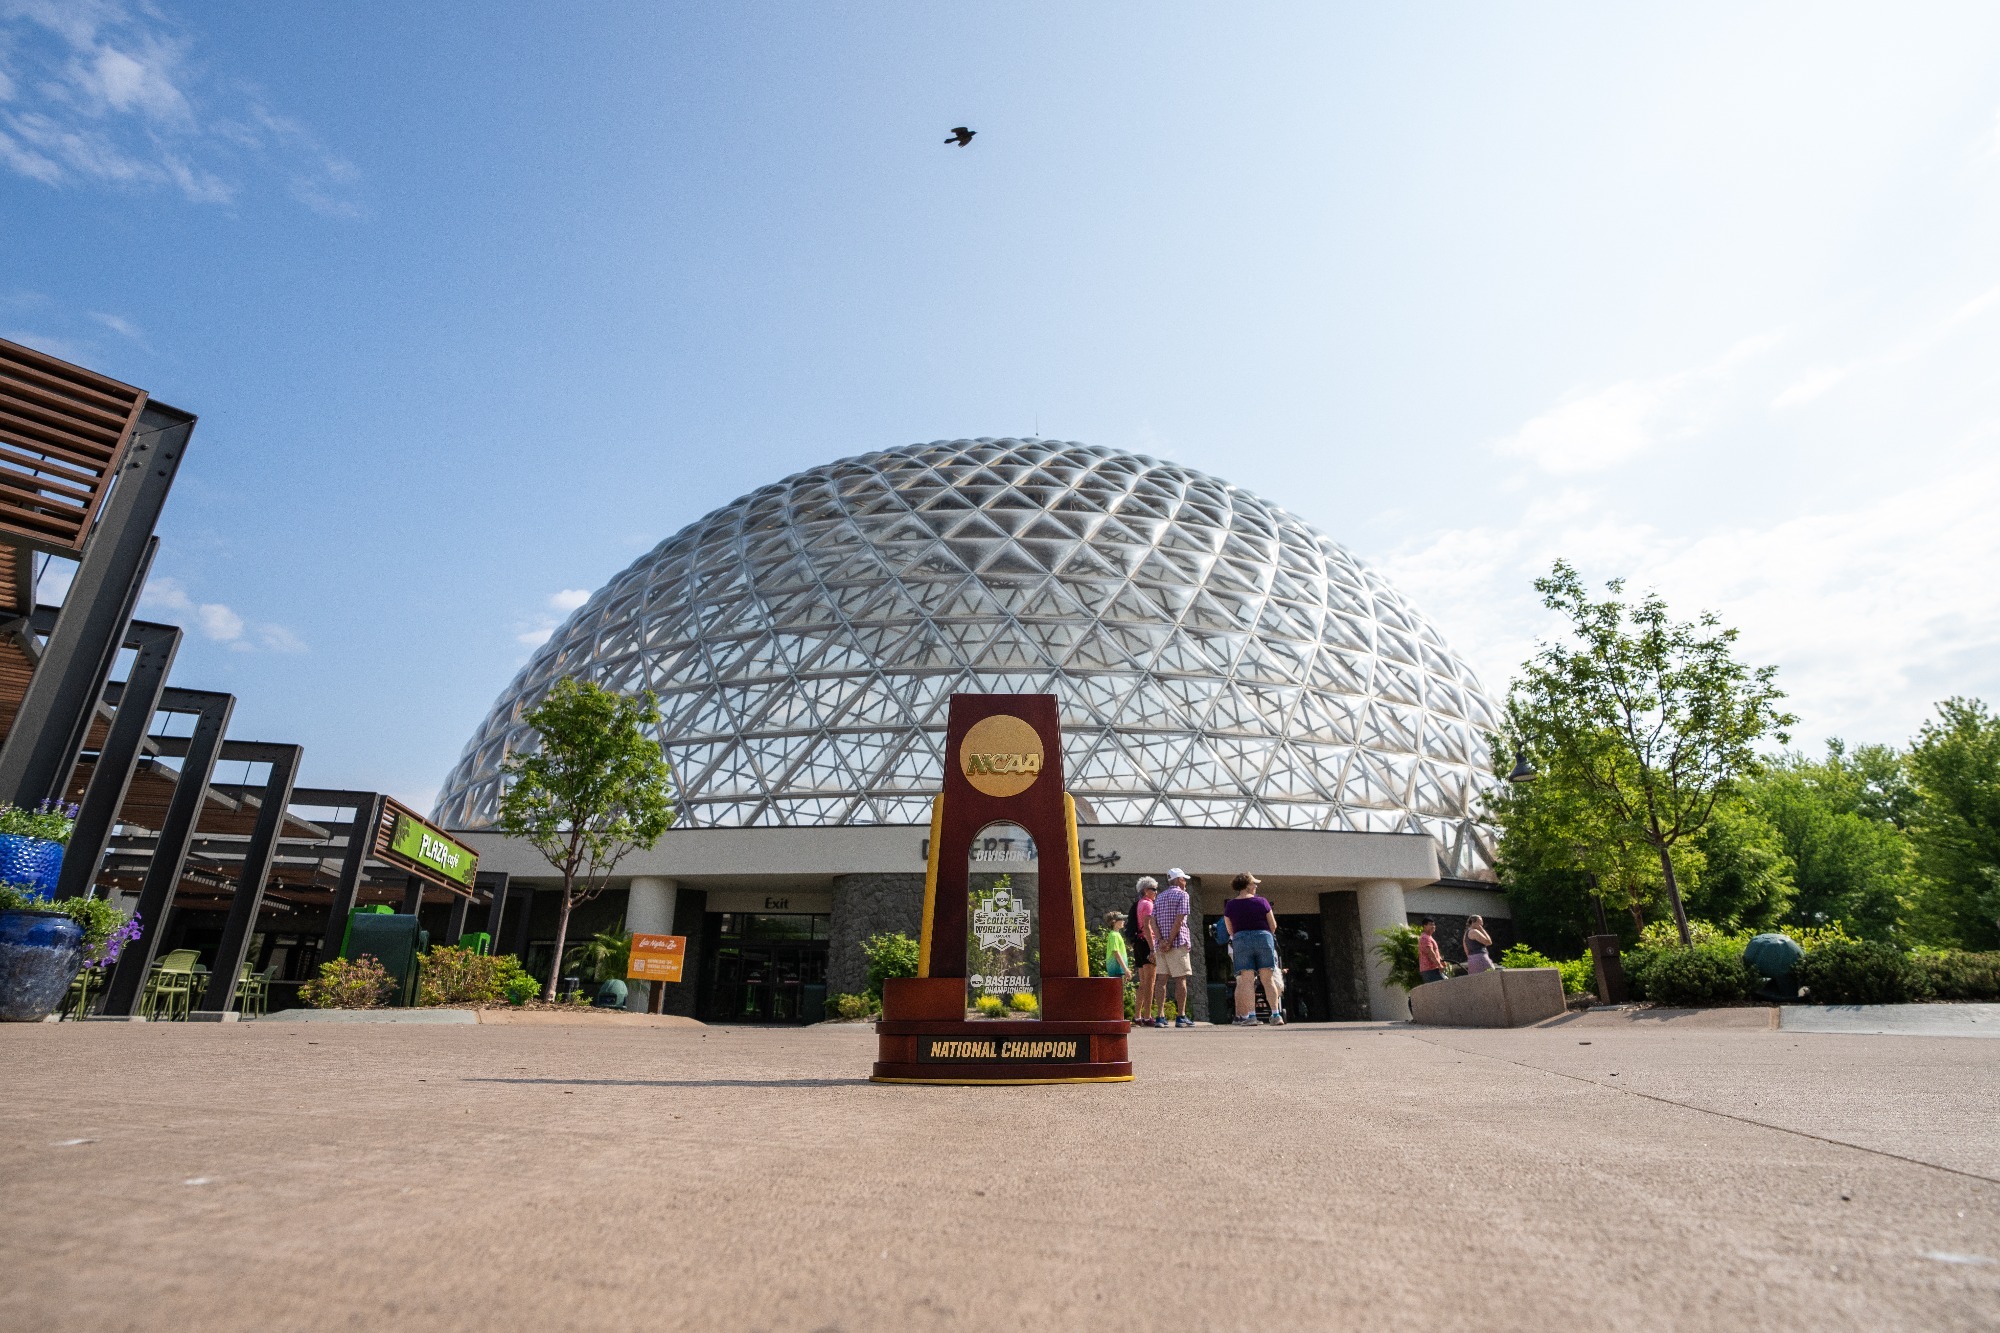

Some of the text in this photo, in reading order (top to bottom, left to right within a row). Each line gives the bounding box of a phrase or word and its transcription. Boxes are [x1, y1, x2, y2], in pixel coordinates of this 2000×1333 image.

[966, 753, 1040, 776] NCAA
[418, 833, 459, 869] PLAZA café
[976, 850, 1024, 862] DIVISION
[765, 897, 789, 910] Exit
[986, 916, 1019, 925] COLLEGE
[975, 925, 1030, 934] WORLD SERIES
[984, 975, 1031, 987] BASEBALL
[930, 1041, 1077, 1058] NATIONAL CHAMPION
